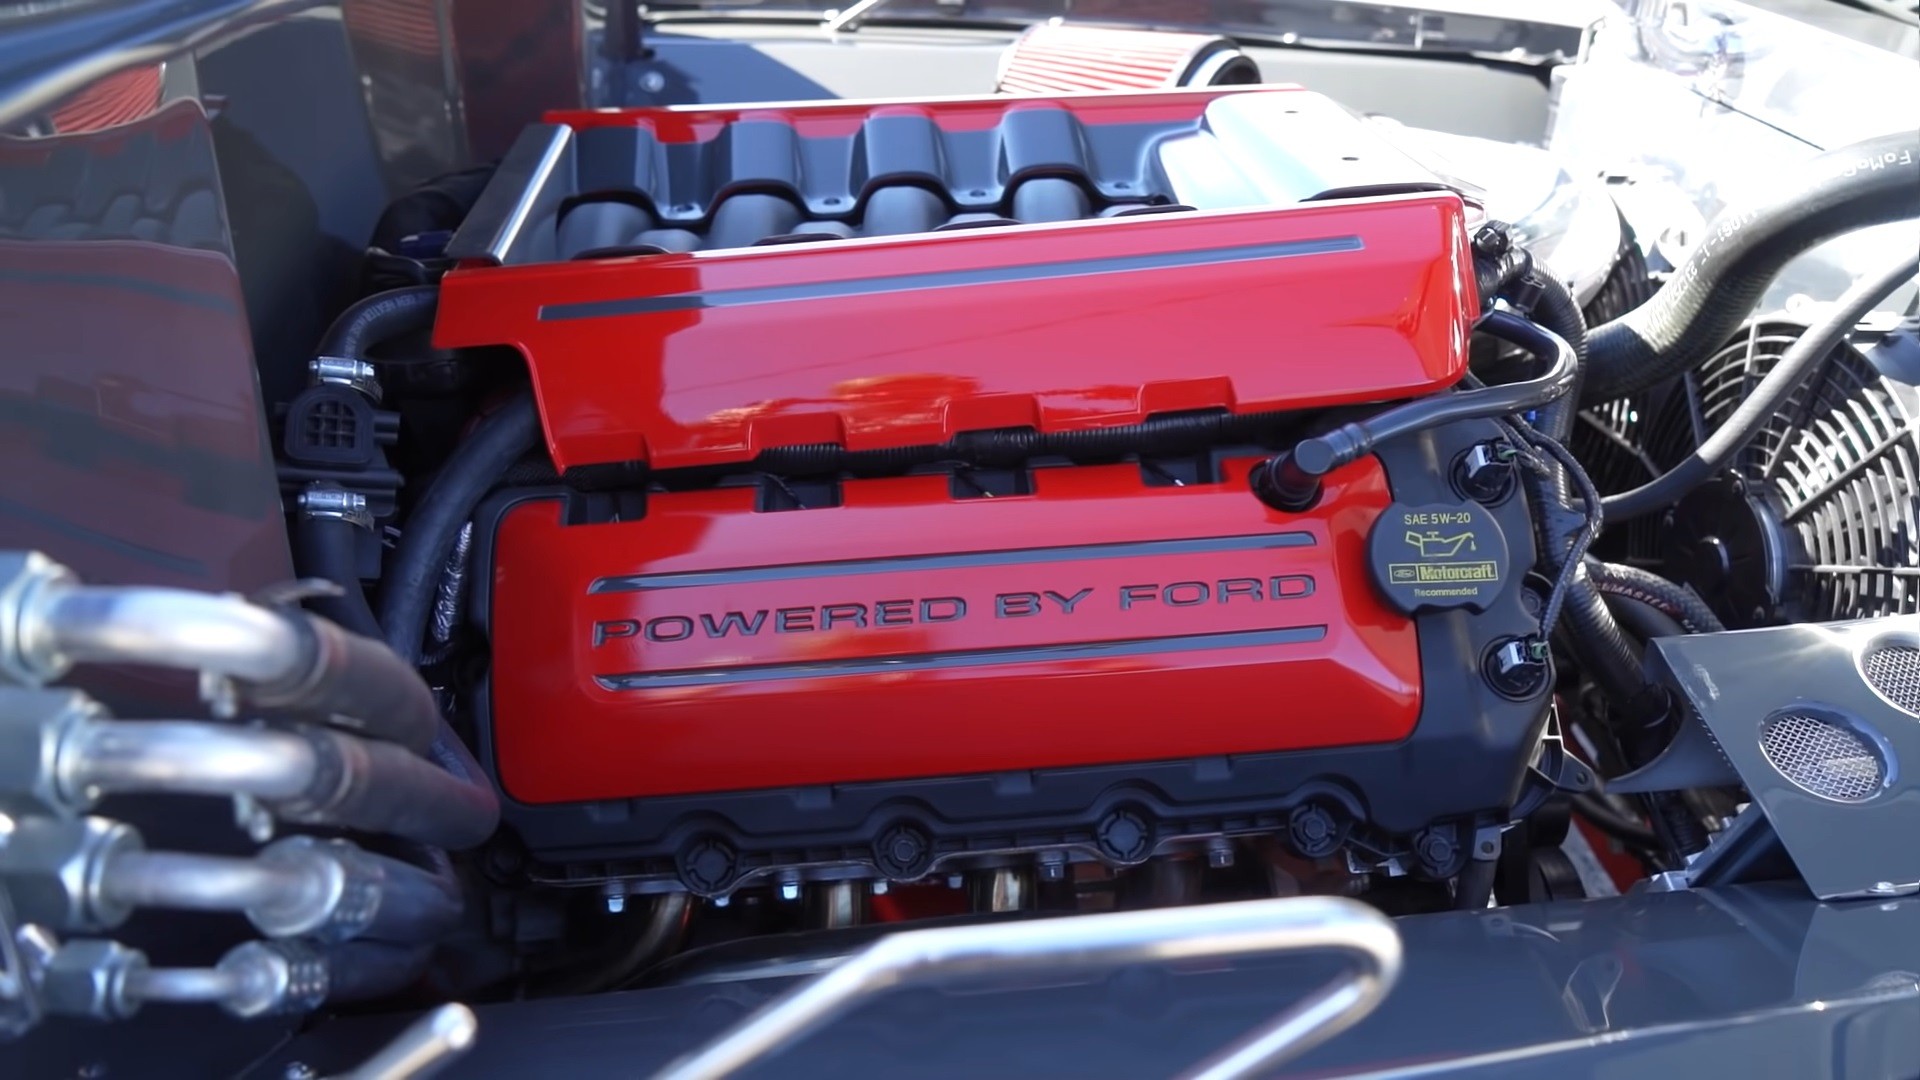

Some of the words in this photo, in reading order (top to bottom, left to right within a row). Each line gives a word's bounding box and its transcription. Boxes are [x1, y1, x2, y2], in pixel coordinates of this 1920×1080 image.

[1404, 513, 1428, 525] SAE
[1430, 512, 1472, 525] 5W-20
[1419, 564, 1495, 581] Motorcraft
[1413, 586, 1478, 597] Recommended
[591, 597, 967, 648] POWERED
[994, 588, 1095, 619] BY
[1119, 574, 1317, 611] FORD
